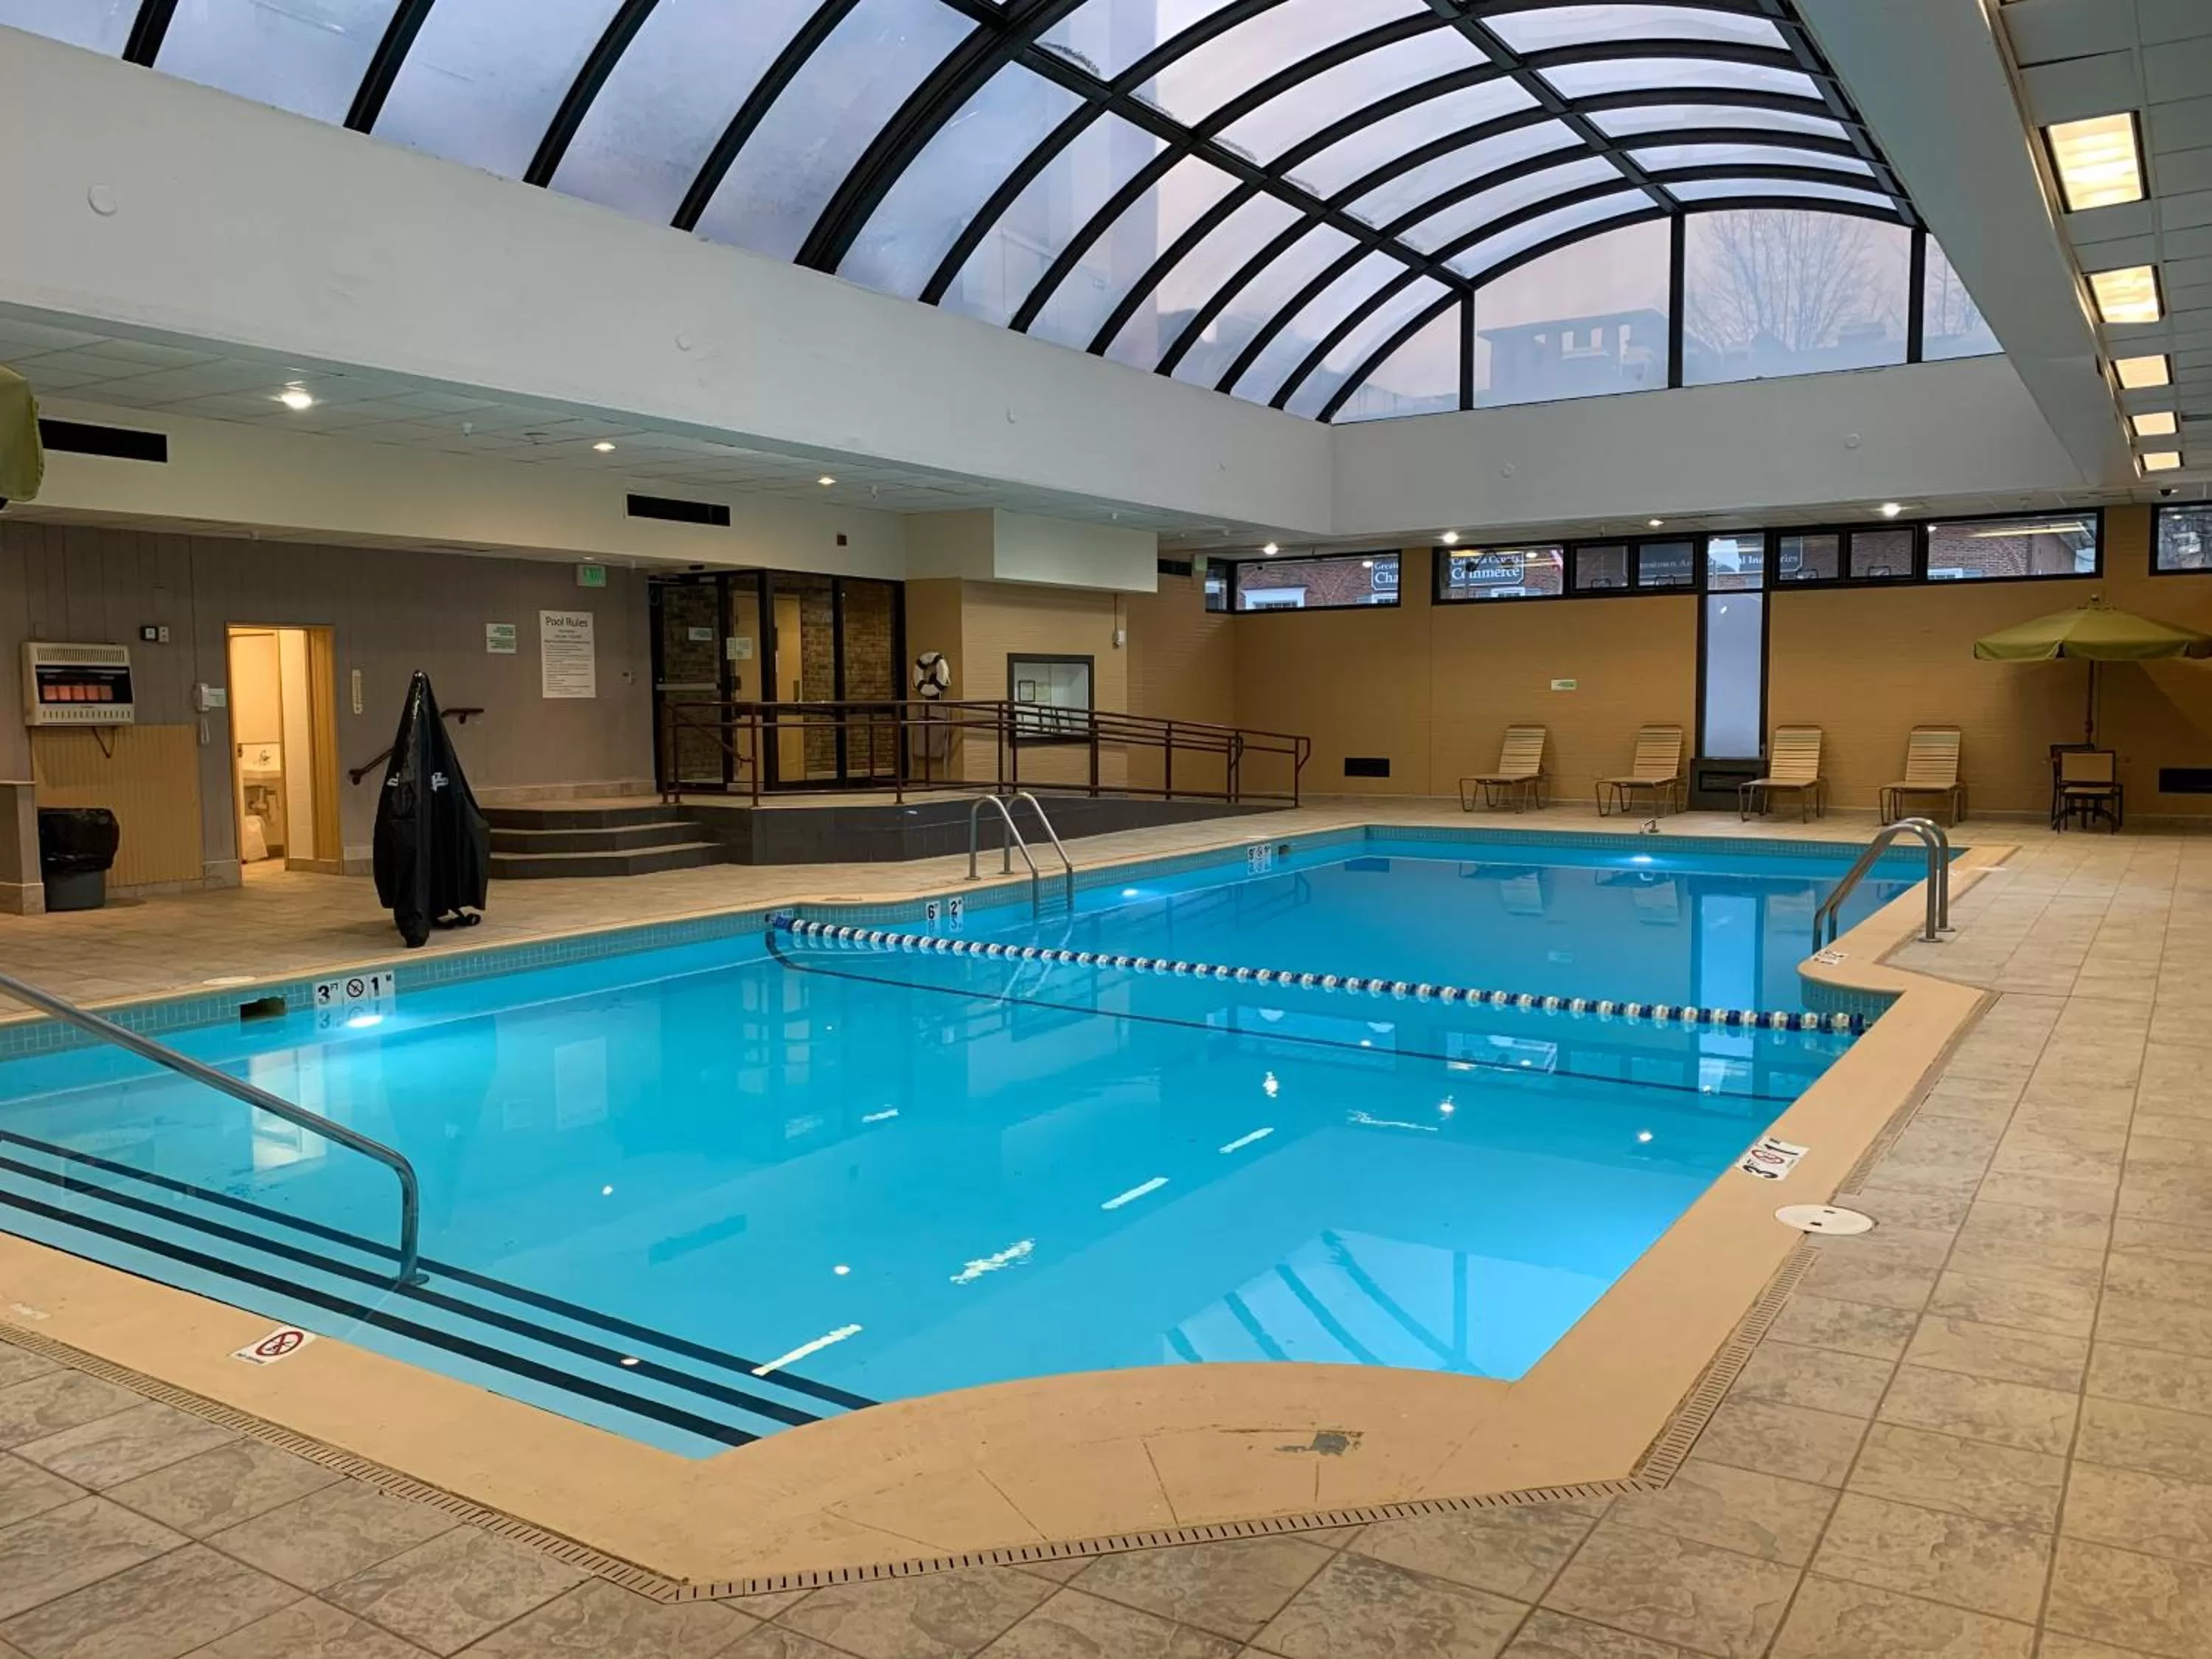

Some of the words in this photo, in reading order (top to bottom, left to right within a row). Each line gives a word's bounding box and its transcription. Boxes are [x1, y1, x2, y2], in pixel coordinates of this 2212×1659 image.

[546, 616, 564, 626] Pool
[566, 617, 588, 627] Rules
[928, 904, 936, 919] 6
